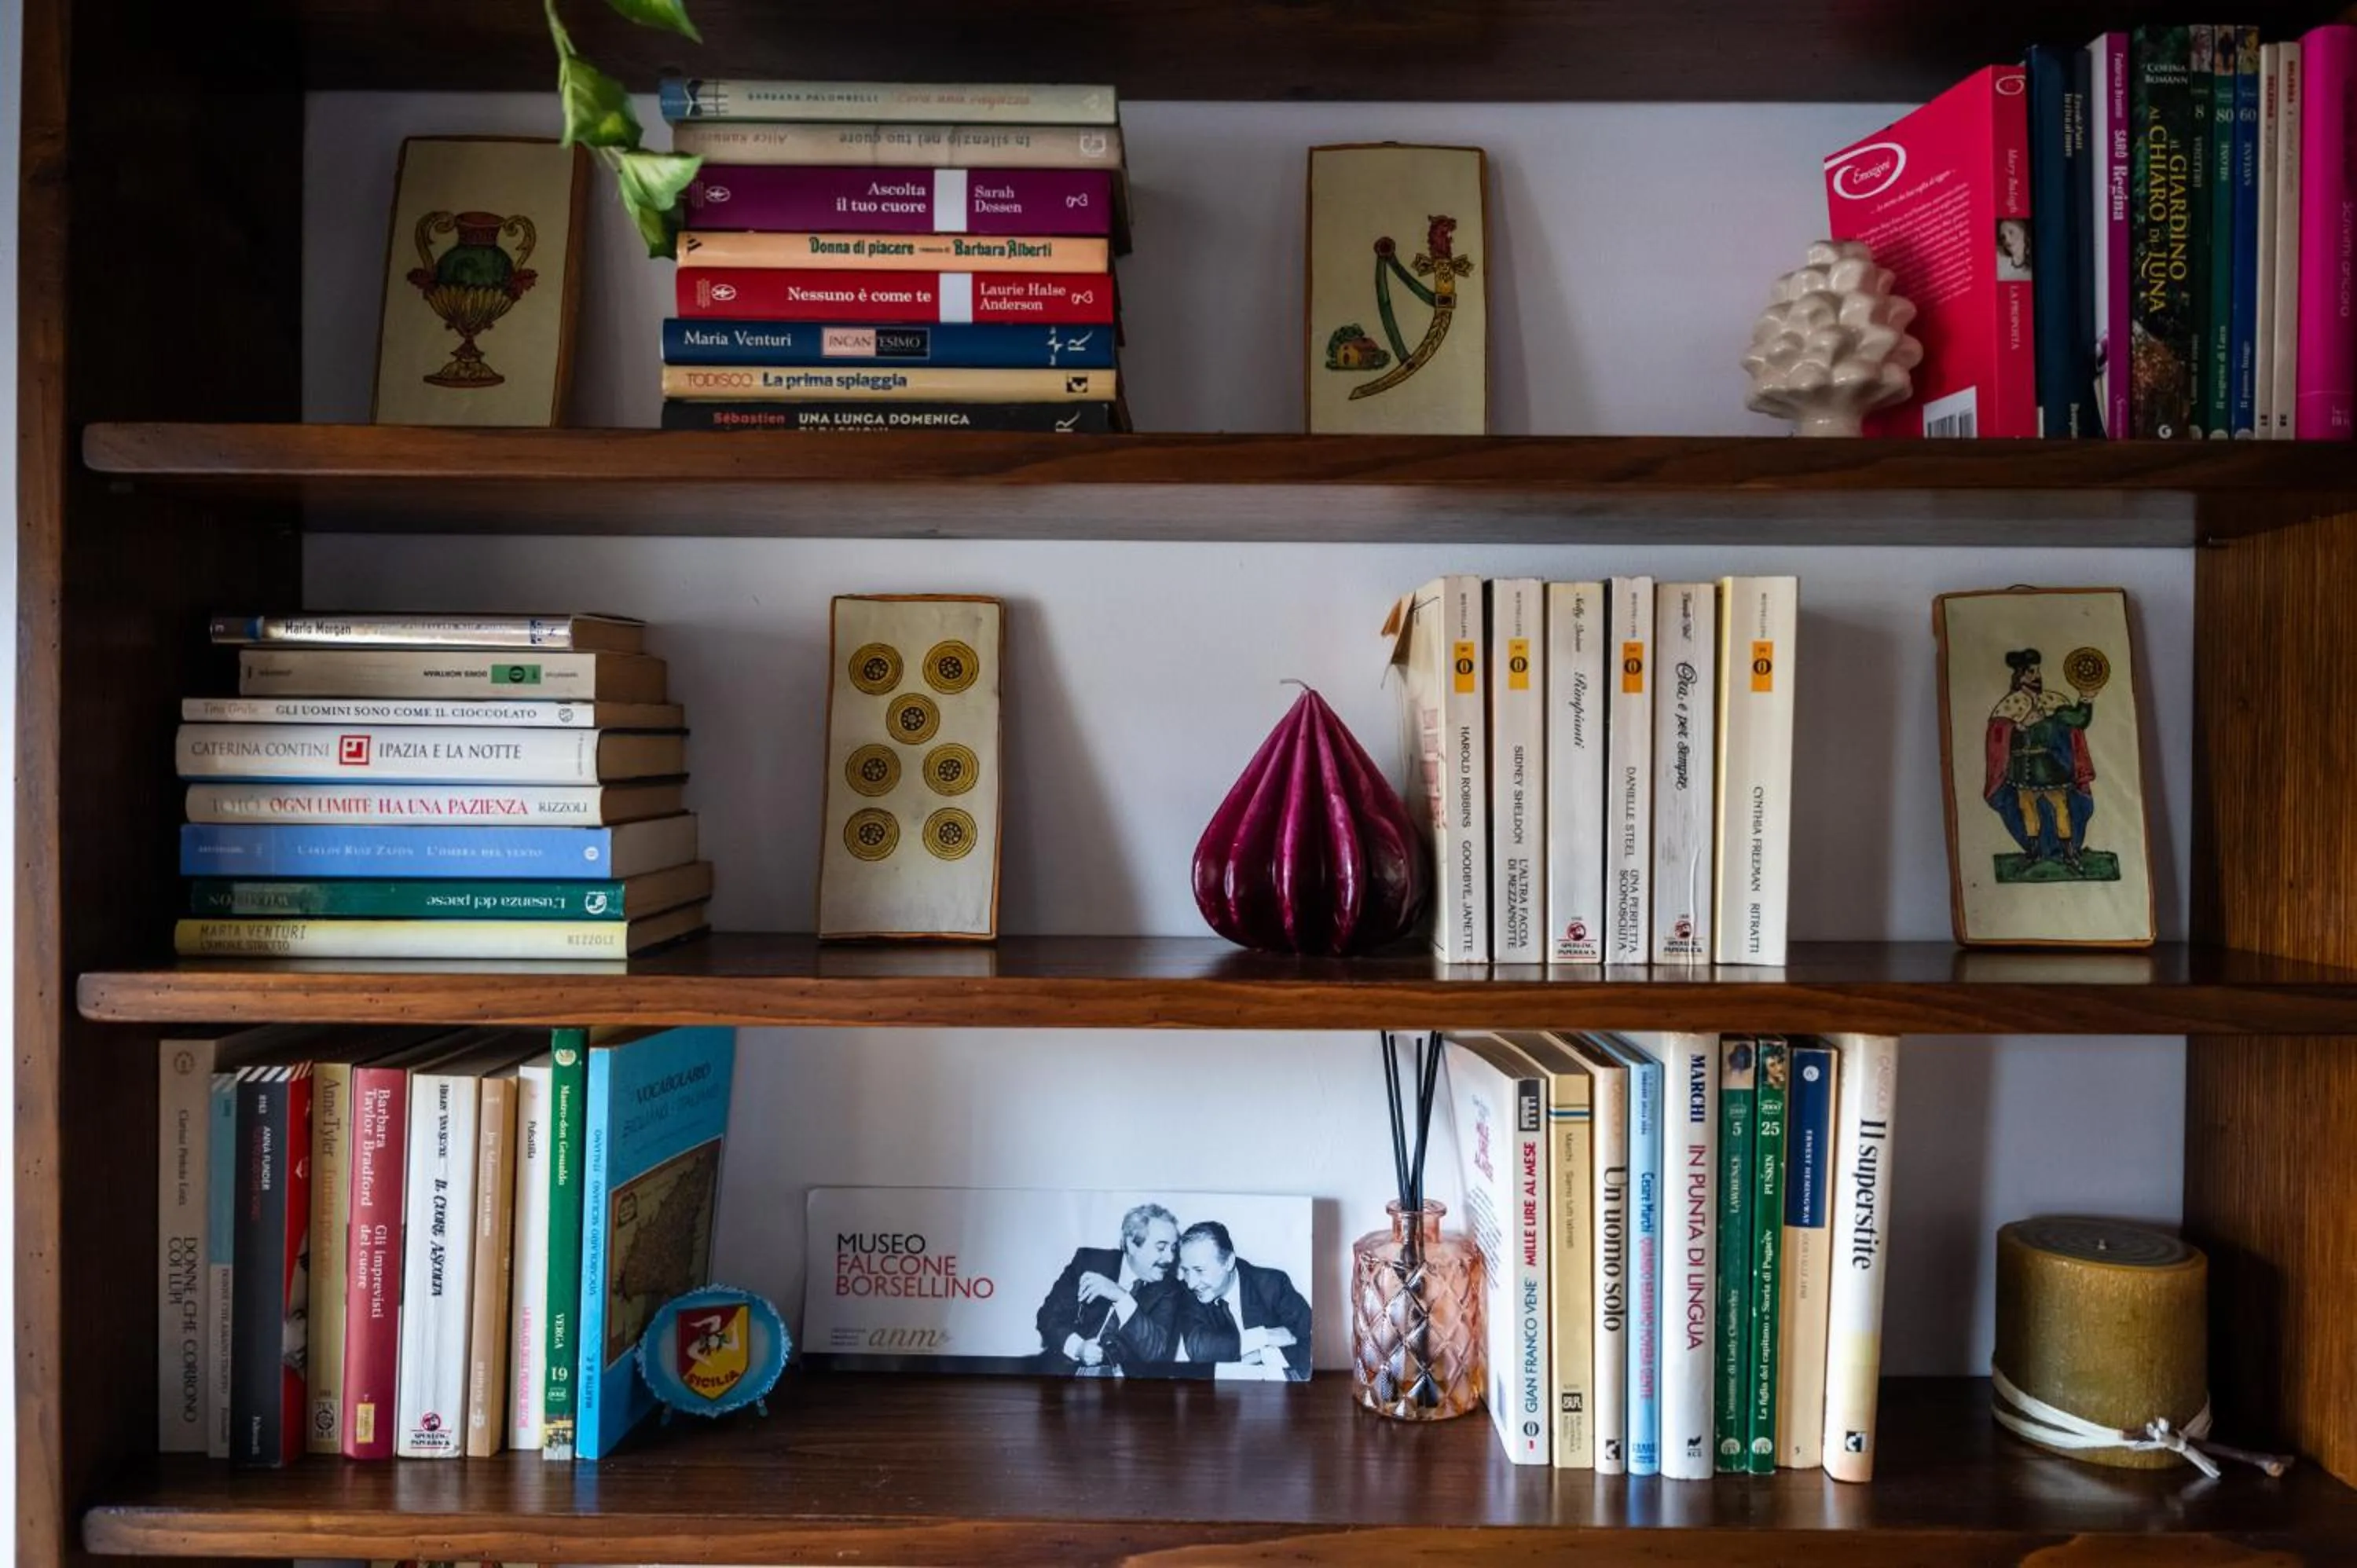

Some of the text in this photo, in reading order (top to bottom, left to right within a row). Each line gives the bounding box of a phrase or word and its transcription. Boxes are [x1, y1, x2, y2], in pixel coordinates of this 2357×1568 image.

[2216, 108, 2234, 123] 80
[2239, 108, 2257, 122] 60
[838, 132, 1031, 148] In silenzio nel tuo cuore
[867, 182, 926, 198] Ascolta
[2149, 124, 2168, 222] CHIARO
[836, 198, 926, 214] il tuo cuore
[974, 185, 1015, 200] Sarah
[974, 200, 1022, 214] Dessen
[2109, 163, 2129, 221] Regina
[2168, 153, 2188, 280] GIARDINO
[809, 237, 851, 255] Donna
[853, 238, 866, 255] di
[867, 240, 915, 258] piacere
[954, 238, 1052, 258] Barbara Alberti
[787, 285, 932, 303] Nessuno è come te
[980, 282, 1066, 298] Laurie Halse
[2011, 284, 2022, 298] LA
[2142, 250, 2168, 313] LUNA
[979, 297, 1043, 311] Anderson
[684, 330, 792, 347] Maria Venturi
[828, 334, 922, 349] INCANTESIMO
[686, 372, 907, 392] TODISCO La prima spiaggia
[798, 412, 830, 426] UNA
[889, 412, 971, 426] DOMENICA
[276, 705, 537, 719] GLI UOMINI SONO COME IL CIOCCOLATO
[1568, 670, 1588, 749] Rimpianti
[191, 741, 330, 757] CATERINA CONTINI
[379, 743, 522, 760] IPAZIA E LA NOTTE
[1461, 726, 1471, 773] HAROLD
[269, 797, 529, 815] OGNI LIMITE HA UNA PAZIENZA
[538, 802, 588, 813] RIZZOLI
[1461, 776, 1472, 828] ROBBINS
[1513, 746, 1523, 845] SIDNEY SHELDON
[1623, 766, 1637, 859] DANIELLE STEEL
[1749, 786, 1765, 954] CYNTHIA FREEMAN RITRATTI
[427, 893, 566, 910] L'usanza del paese
[1507, 859, 1517, 950] DI MEZZANOTTE
[1518, 858, 1528, 947] L'ALTRA FACCIA
[1617, 870, 1629, 951] SCONOSCIUTA
[1628, 870, 1640, 954] UNA PERFETTA
[248, 924, 306, 940] VENTURI
[1462, 902, 1473, 953] JANETTE
[323, 1076, 341, 1116] Anne
[1690, 1054, 1706, 1123] MARCHI
[319, 1117, 341, 1158] Tyler
[377, 1089, 391, 1149] Barbara
[558, 1085, 570, 1186] Mastro-don Gesualdo
[1732, 1120, 1743, 1137] 5
[1761, 1120, 1780, 1136] 25
[1859, 1119, 1887, 1140] Il
[262, 1125, 271, 1191] ANNA FUNDER
[361, 1088, 376, 1207] Taylor Bradford
[588, 1129, 603, 1296] VOCABOLARIO SICILIANO ITALIANO
[1523, 1141, 1536, 1267] MILLE LIRE AL MESE
[1802, 1166, 1811, 1225] HEMINGWAY
[1852, 1145, 1881, 1270] superstite
[168, 1236, 183, 1268] COI
[358, 1224, 372, 1289] del cuore
[836, 1233, 926, 1255] MUSEO
[1602, 1164, 1627, 1332] Un uomo solo
[1687, 1145, 1706, 1350] IN PUNTA DI LINGUA
[371, 1225, 388, 1318] Gli imprevisti
[431, 1240, 445, 1297] ASCOLTA
[836, 1254, 957, 1277] FALCONE
[835, 1274, 995, 1299] BORSELLINO
[181, 1236, 198, 1423] DONNE CHE CORRONO
[554, 1312, 565, 1349] VERGA
[1524, 1317, 1538, 1374] FRANCO
[687, 1369, 741, 1389] SICILIA
[1524, 1377, 1538, 1413] GIAN
